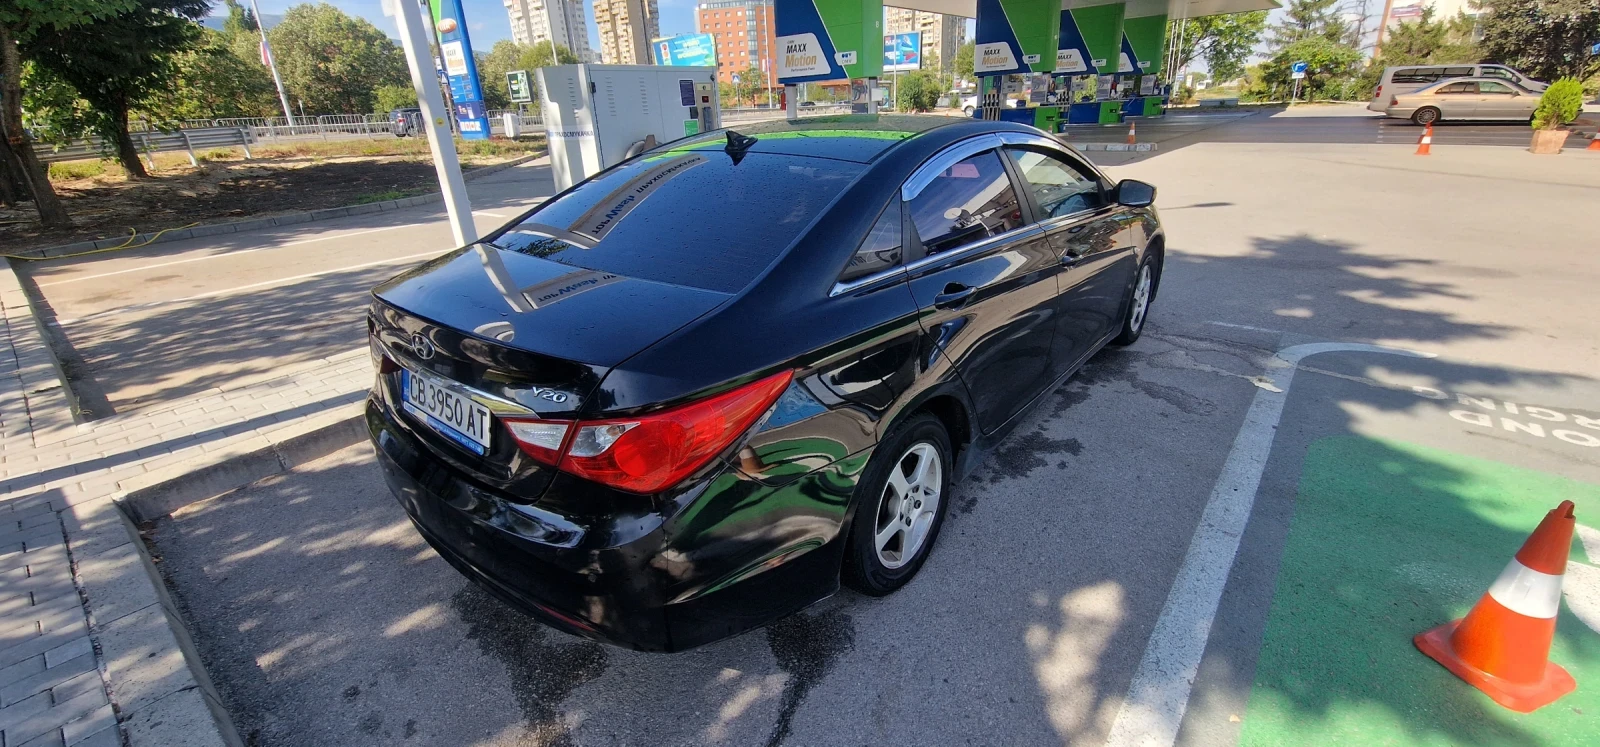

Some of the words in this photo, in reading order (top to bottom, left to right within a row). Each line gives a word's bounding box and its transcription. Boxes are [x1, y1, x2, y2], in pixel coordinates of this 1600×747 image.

[786, 43, 807, 54] MAXX
[785, 54, 817, 68] Motion
[982, 56, 1008, 65] Motion
[532, 386, 568, 403] Y20
[410, 374, 426, 406] CB
[429, 384, 463, 428] 3950
[466, 404, 487, 440] AT
